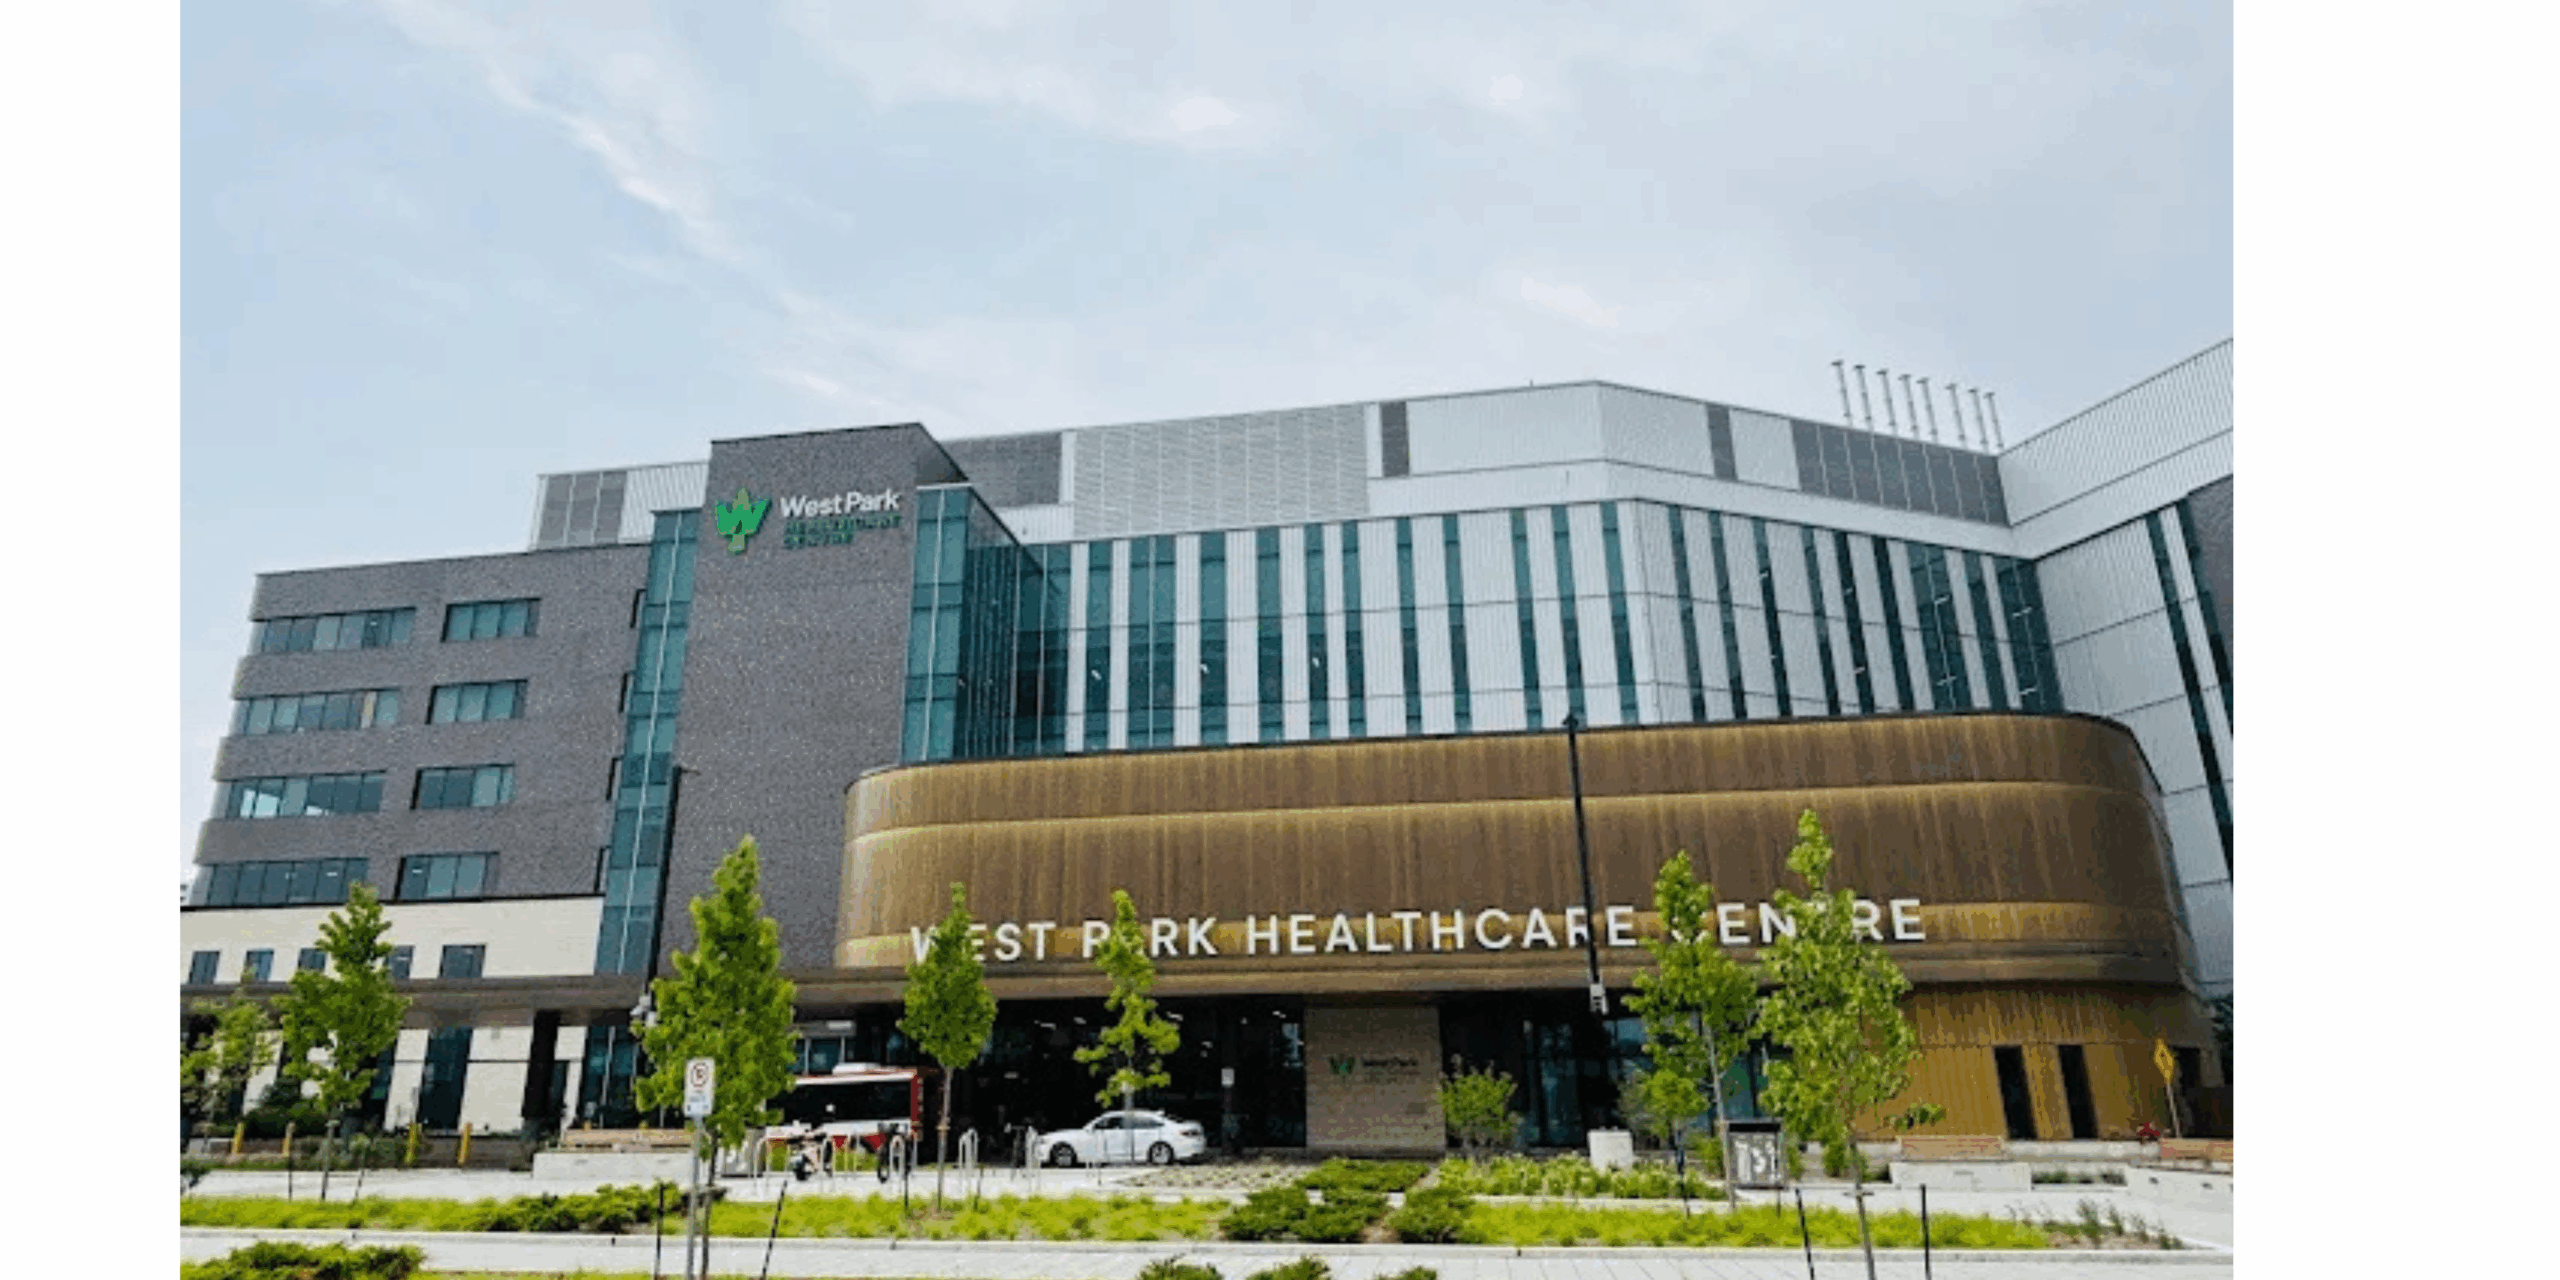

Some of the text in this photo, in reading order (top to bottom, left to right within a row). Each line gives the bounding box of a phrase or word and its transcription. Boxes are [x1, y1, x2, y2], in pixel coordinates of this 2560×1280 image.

[780, 488, 902, 517] West Park
[1082, 917, 1219, 959] PRK
[1247, 905, 1637, 956] HEALTHCARE
[1669, 898, 1927, 946] ENRE
